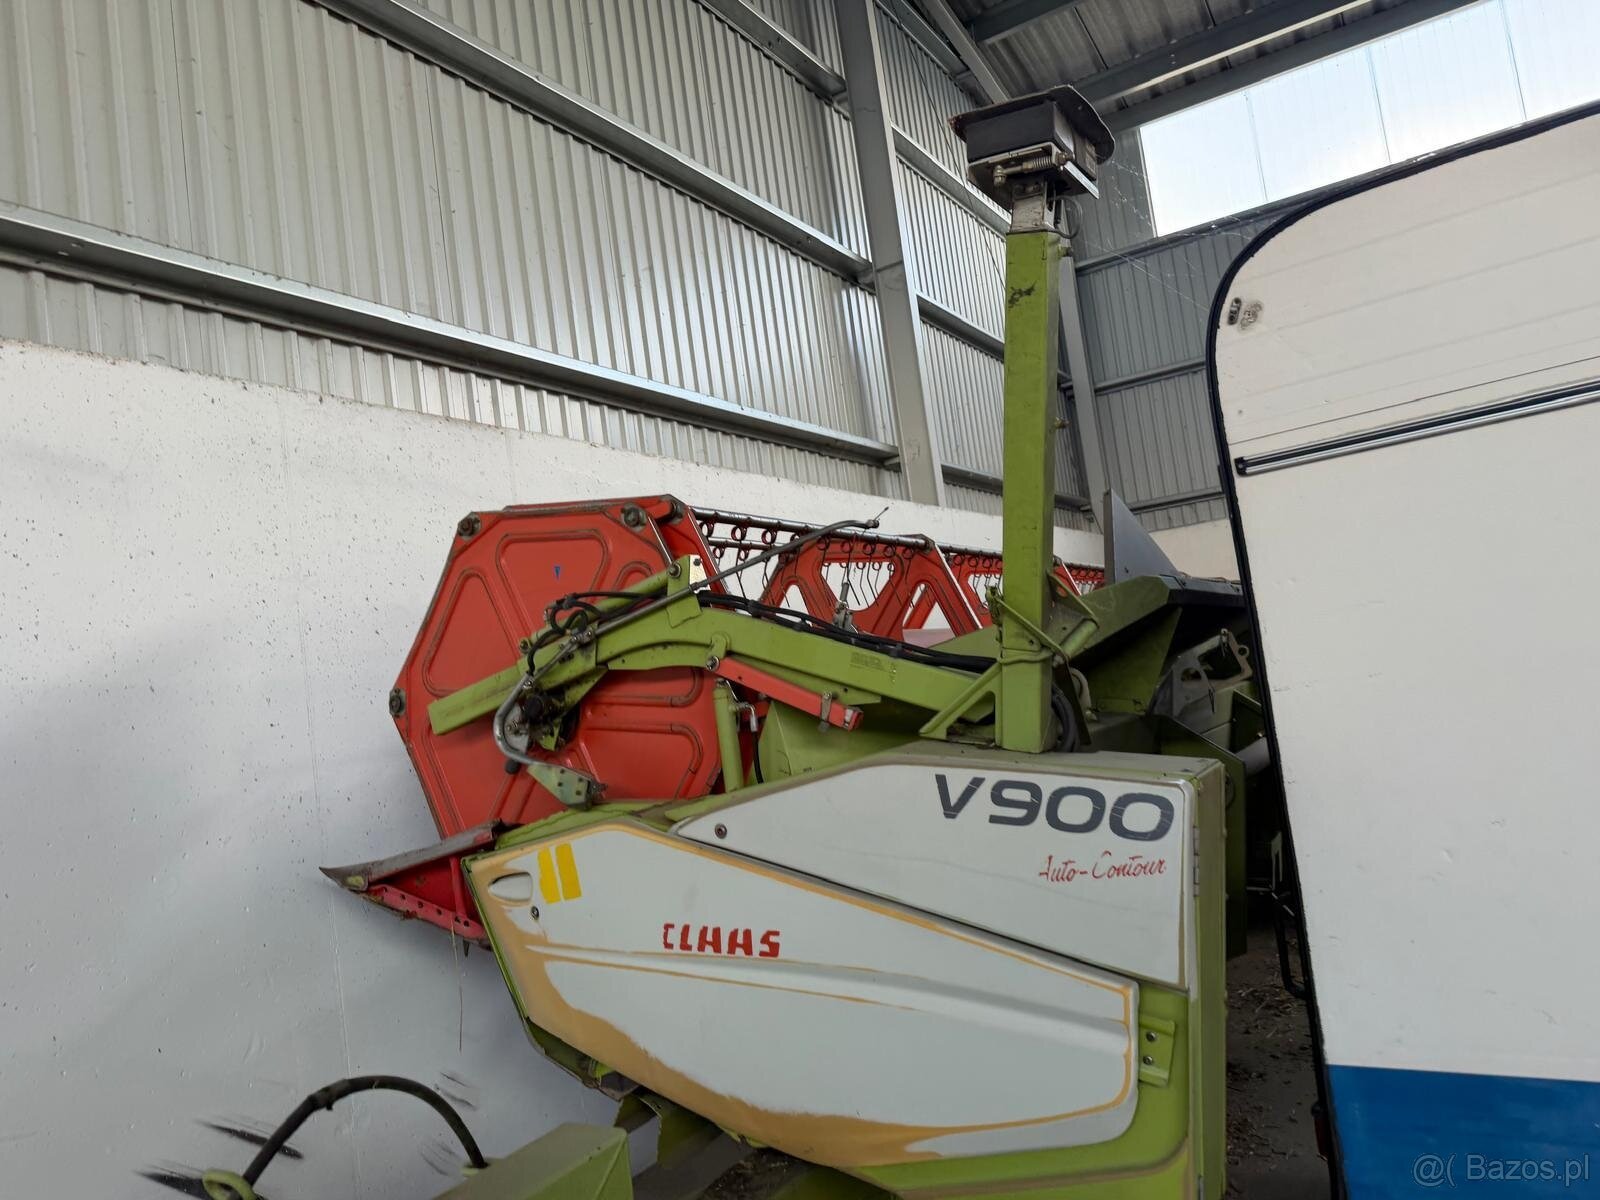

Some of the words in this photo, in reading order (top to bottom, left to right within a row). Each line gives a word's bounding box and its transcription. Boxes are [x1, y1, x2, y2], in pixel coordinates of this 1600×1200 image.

[935, 774, 1175, 841] V900
[1039, 850, 1166, 882] Auto-Contour
[662, 923, 780, 958] CLAAS
